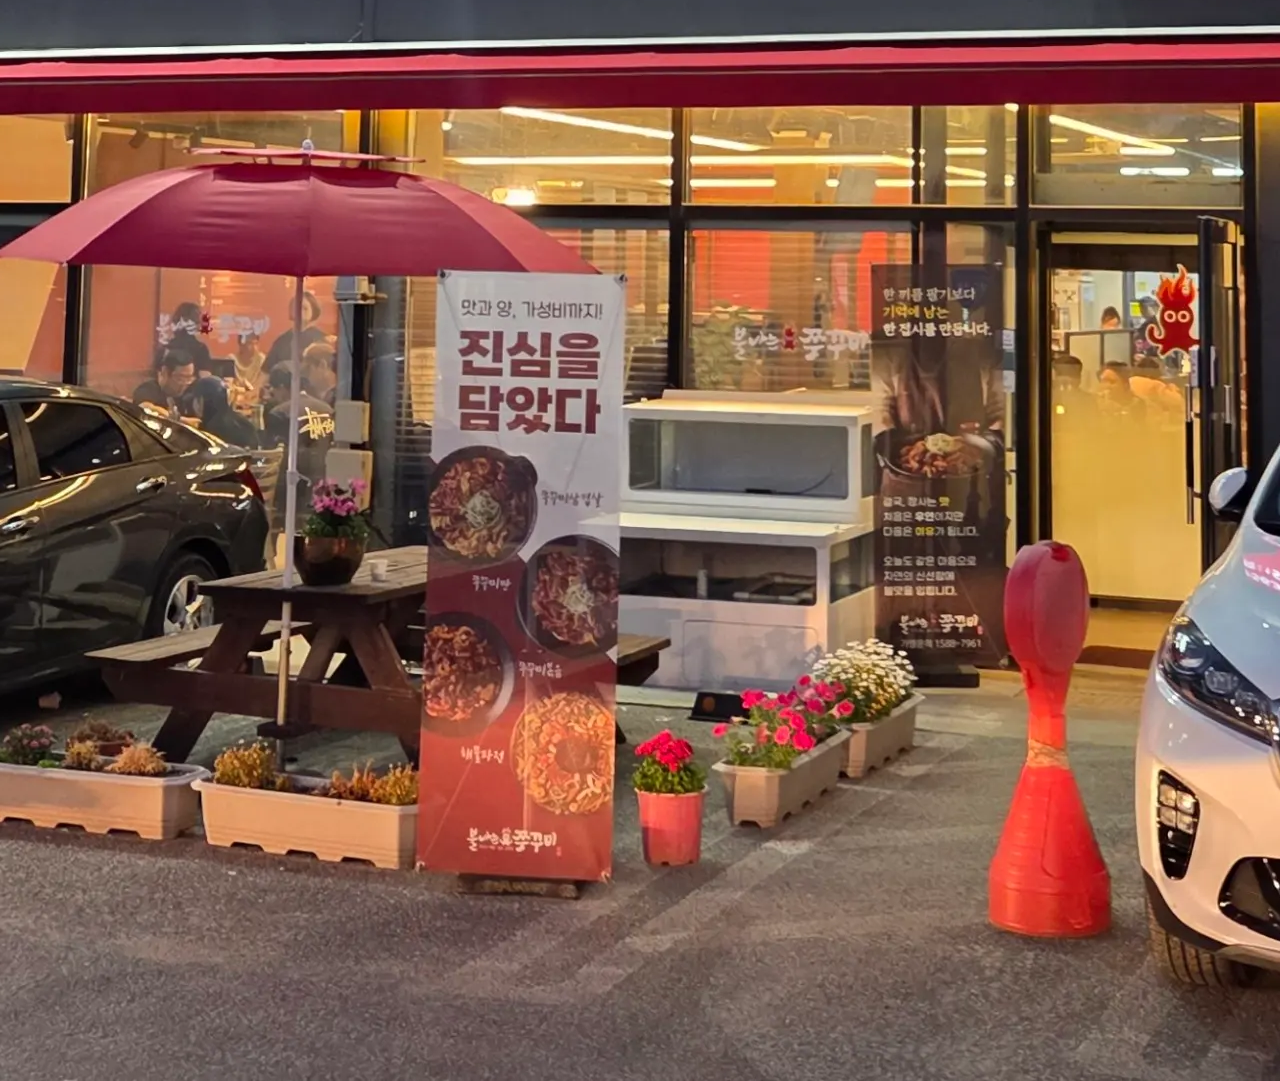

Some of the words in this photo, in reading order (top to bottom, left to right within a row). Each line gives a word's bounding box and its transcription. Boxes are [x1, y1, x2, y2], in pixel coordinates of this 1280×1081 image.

[461, 299, 492, 317] 맛과
[521, 301, 604, 321] 가성비까지!
[882, 302, 920, 318] 기억에
[923, 304, 950, 319] 남는
[731, 326, 779, 360] 불나는
[882, 321, 897, 337] 한
[899, 321, 938, 337] 접시를
[458, 330, 601, 380] 진심을
[458, 385, 601, 435] 담았다
